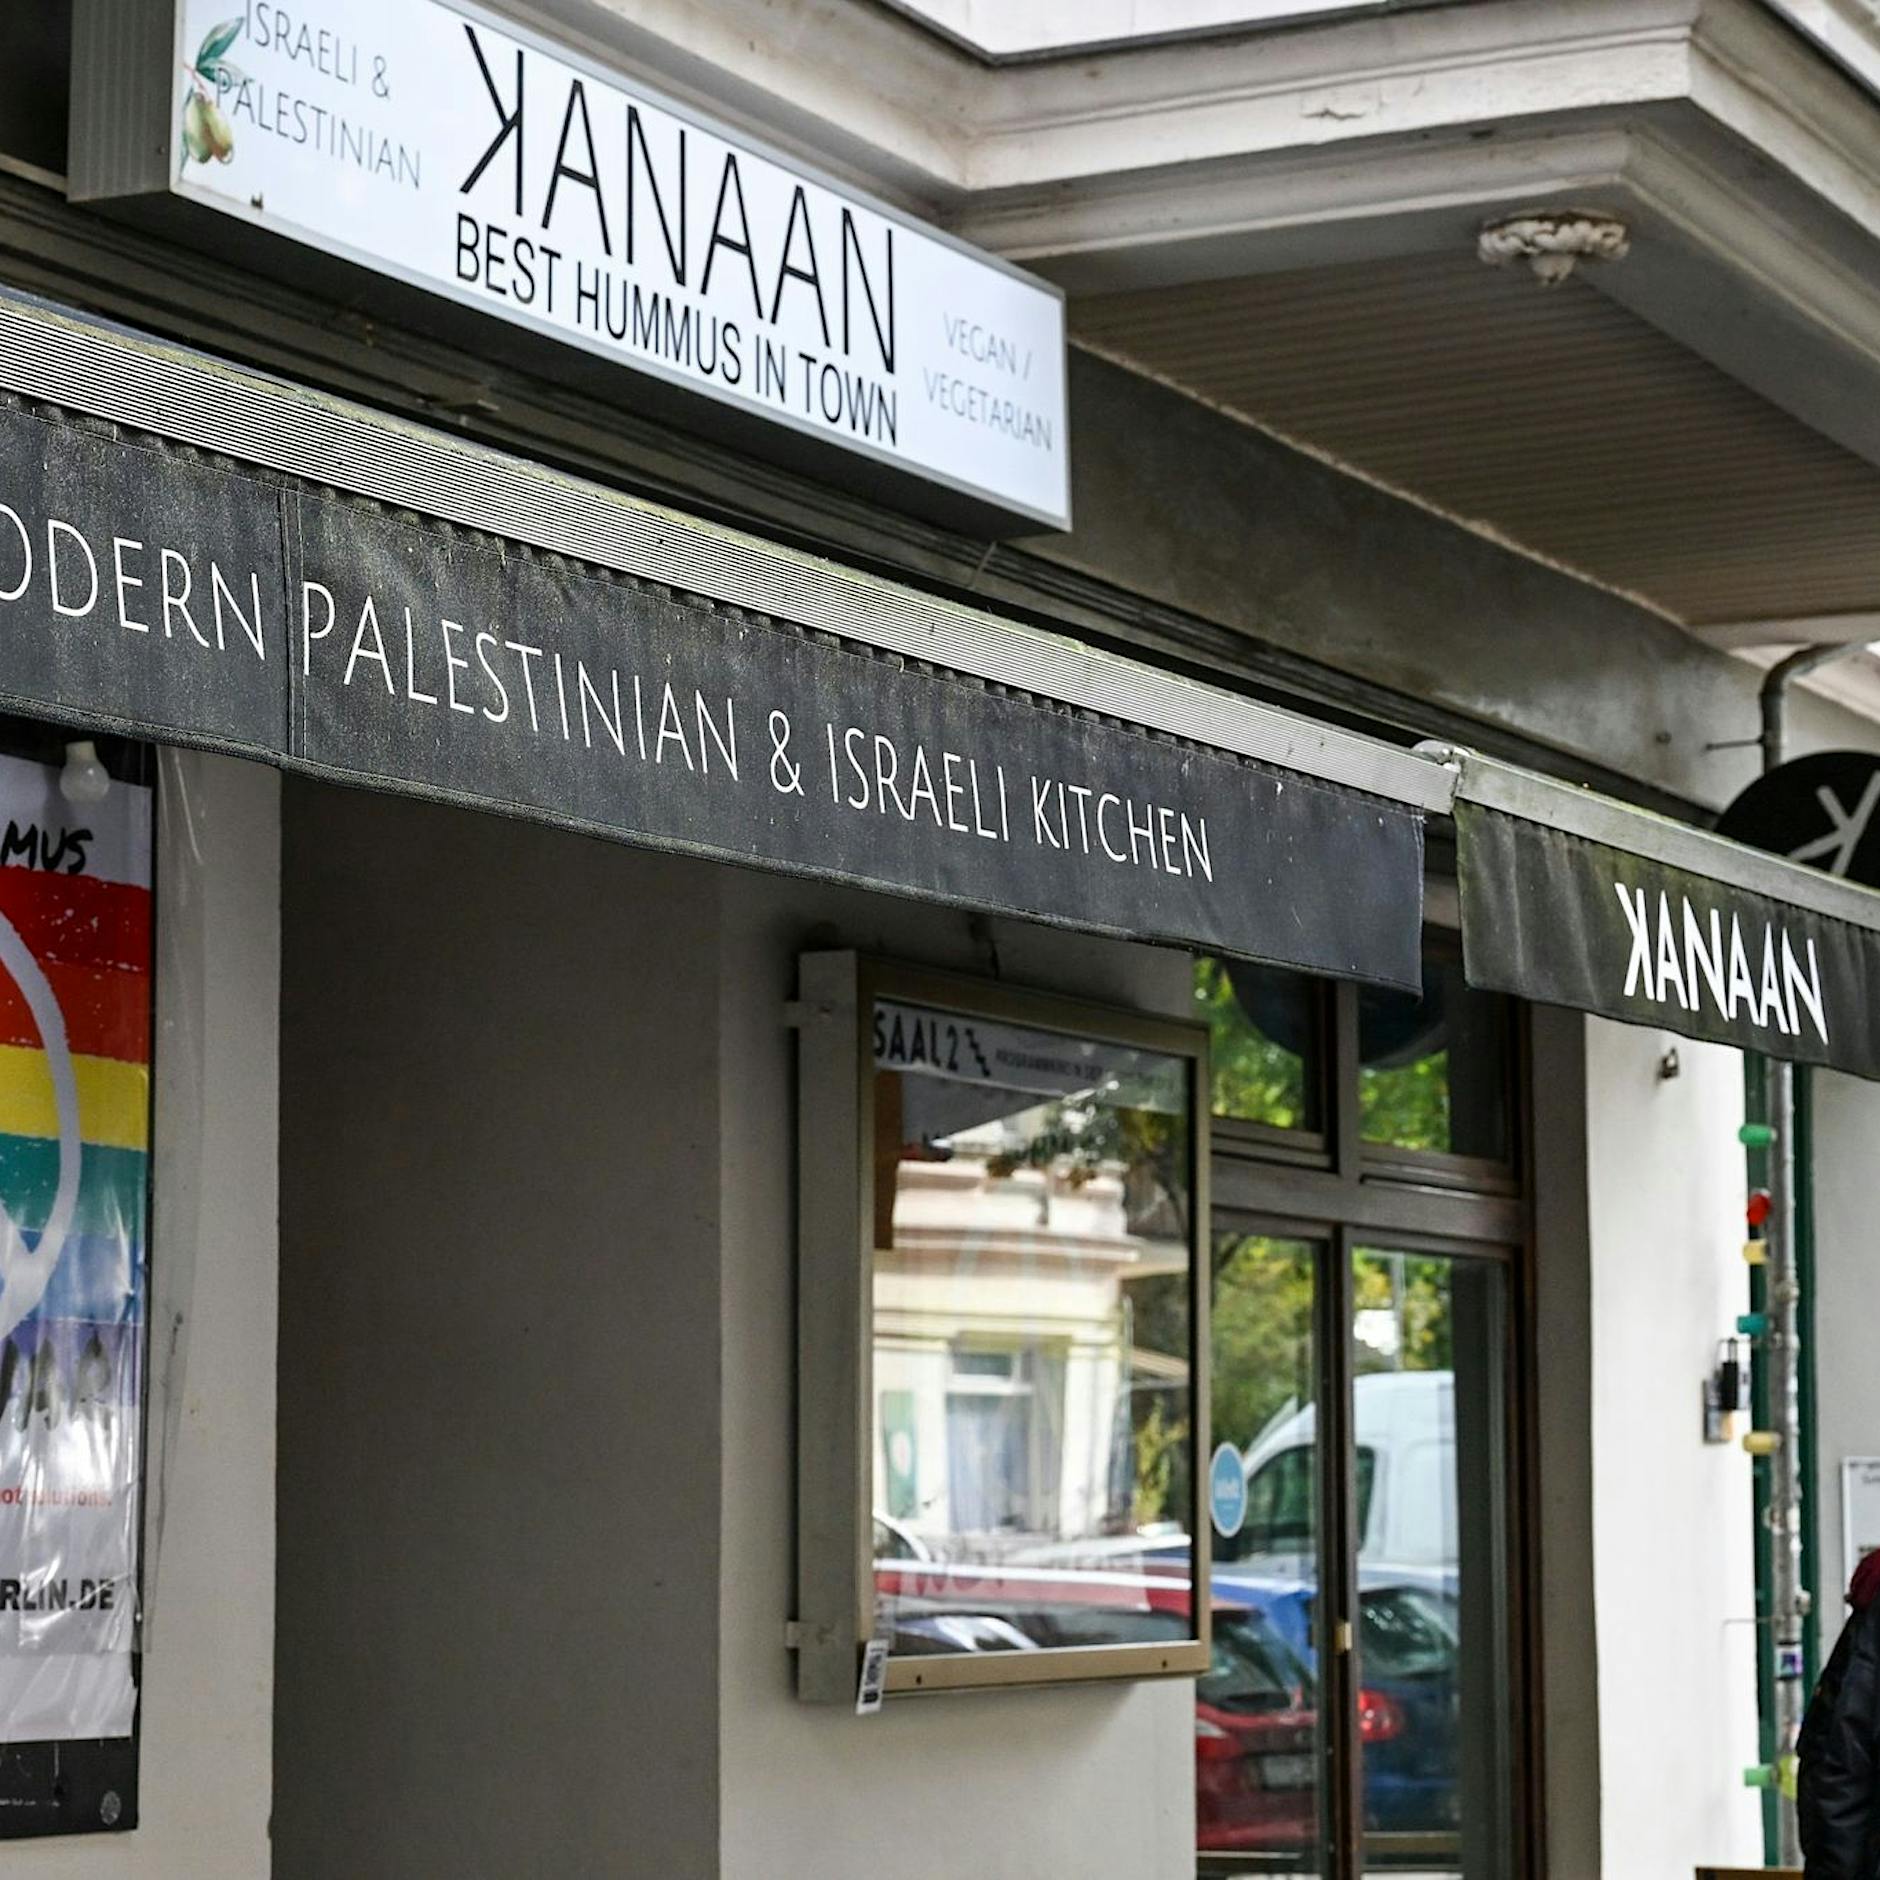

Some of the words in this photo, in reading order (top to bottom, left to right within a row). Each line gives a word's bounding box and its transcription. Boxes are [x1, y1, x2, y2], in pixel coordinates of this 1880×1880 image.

[246, 0, 357, 85] ISRAELI
[371, 55, 391, 100] &
[216, 67, 421, 190] PALESTINIAN
[459, 24, 896, 375] KANAAN
[456, 212, 562, 314] BEST
[577, 261, 741, 385] HUMMUS
[755, 334, 786, 403] IN
[799, 352, 897, 447] TOWN
[943, 311, 1016, 375] VEGAN
[922, 366, 1052, 452] VEGETARIAN
[303, 581, 738, 781] PALESTINIAN
[768, 709, 804, 796] &
[826, 723, 1009, 841] ISRAELI
[1031, 776, 1213, 882] KITCHEN
[0, 820, 94, 875] MUS
[1614, 882, 1829, 1045] KANAAN
